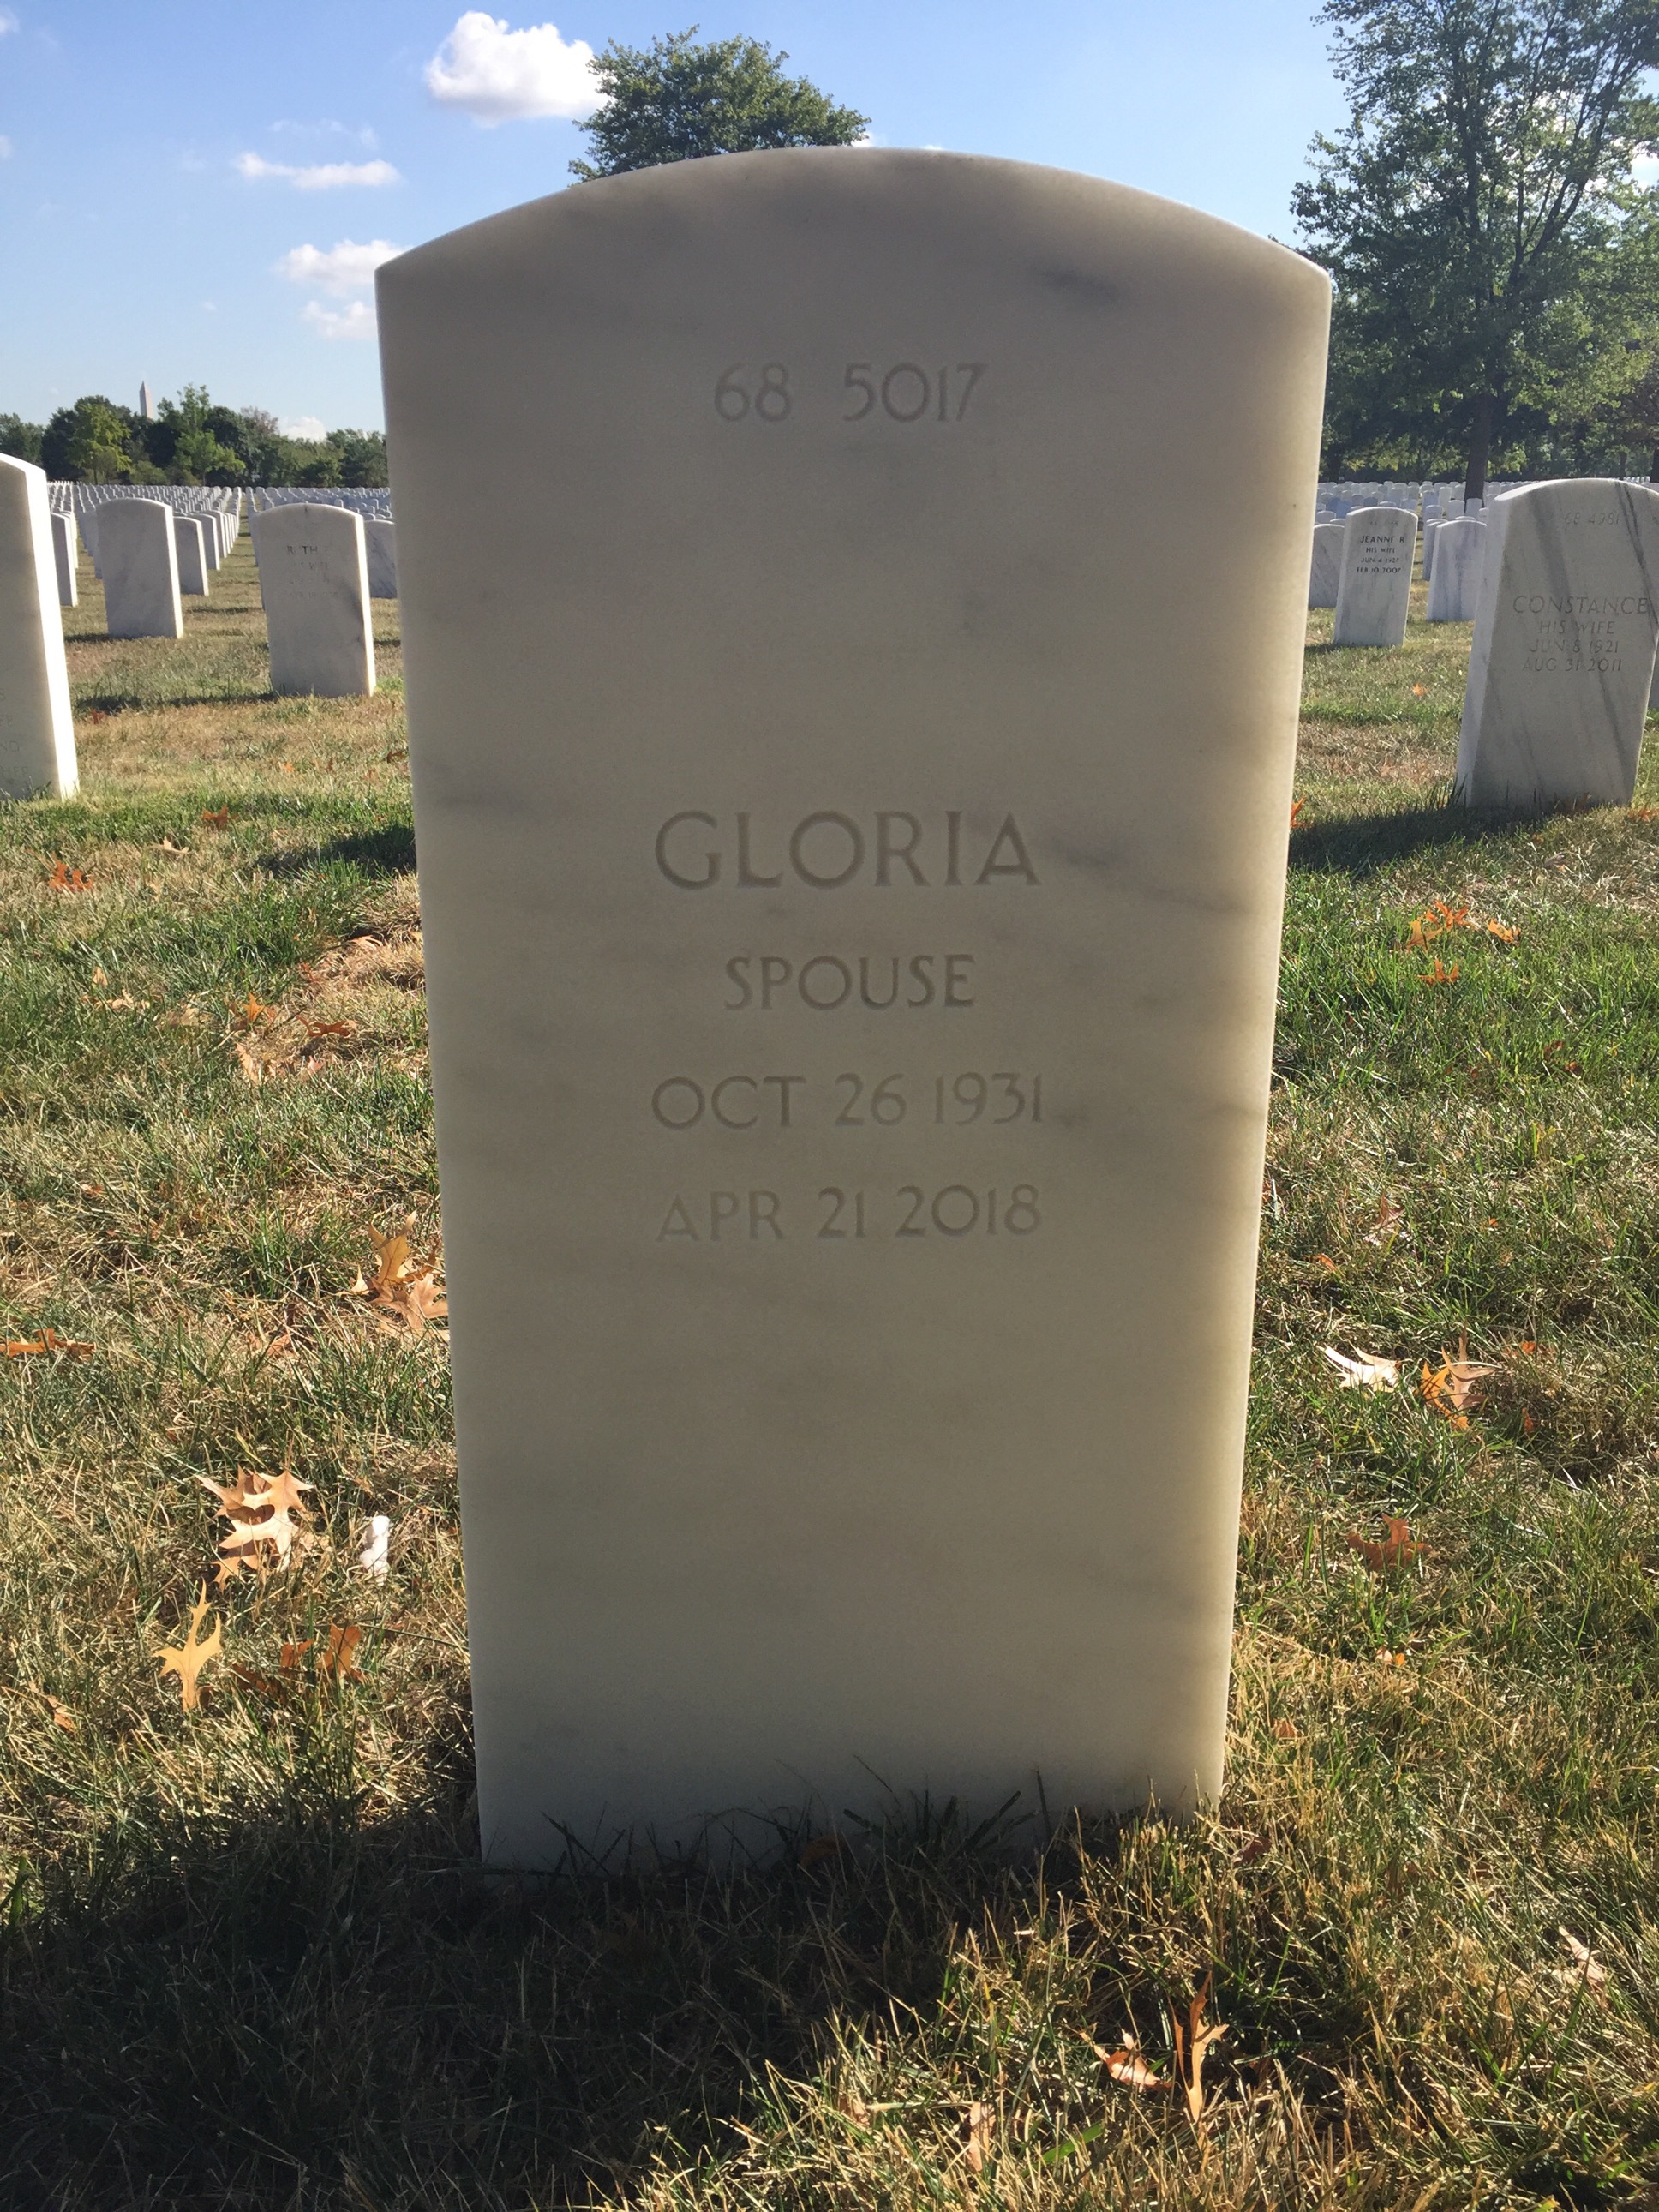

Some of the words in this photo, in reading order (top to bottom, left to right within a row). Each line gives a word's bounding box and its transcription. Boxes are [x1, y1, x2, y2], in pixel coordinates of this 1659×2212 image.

[714, 362, 792, 423] 68
[842, 362, 989, 423] 5017
[1512, 595, 1649, 615] CONSTANCE
[1539, 620, 1566, 635] HIS
[1574, 620, 1616, 635] WIFE
[1522, 657, 1557, 672] AUG
[1565, 658, 1581, 672] 31
[1587, 657, 1622, 673] 2011
[1530, 638, 1566, 653] JUN
[1572, 638, 1581, 653] 8
[1589, 639, 1619, 654] 1921
[655, 809, 1042, 891] GLORIA
[723, 953, 976, 1011] SPOUSE
[651, 1075, 807, 1130] OCT
[834, 1072, 908, 1127] 26
[933, 1071, 1043, 1126] 1931
[655, 1190, 786, 1242] APR
[817, 1186, 867, 1239] 21
[895, 1184, 1043, 1238] 2018
